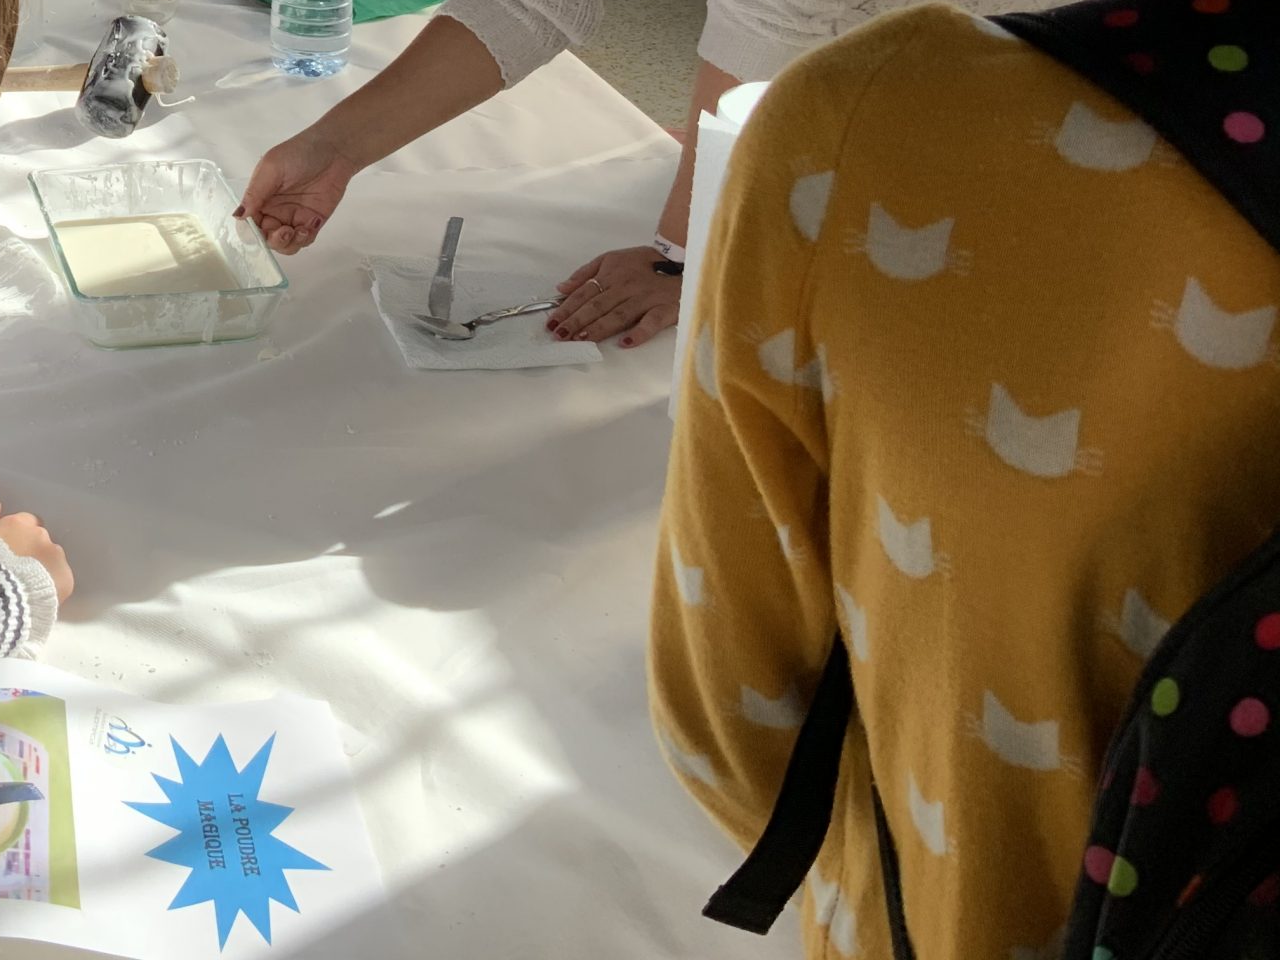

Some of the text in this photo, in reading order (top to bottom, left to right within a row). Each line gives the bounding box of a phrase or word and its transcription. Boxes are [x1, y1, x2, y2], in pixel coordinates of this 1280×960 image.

[197, 800, 226, 870] MAGIQUE
[228, 793, 261, 876] LA POUDRE
